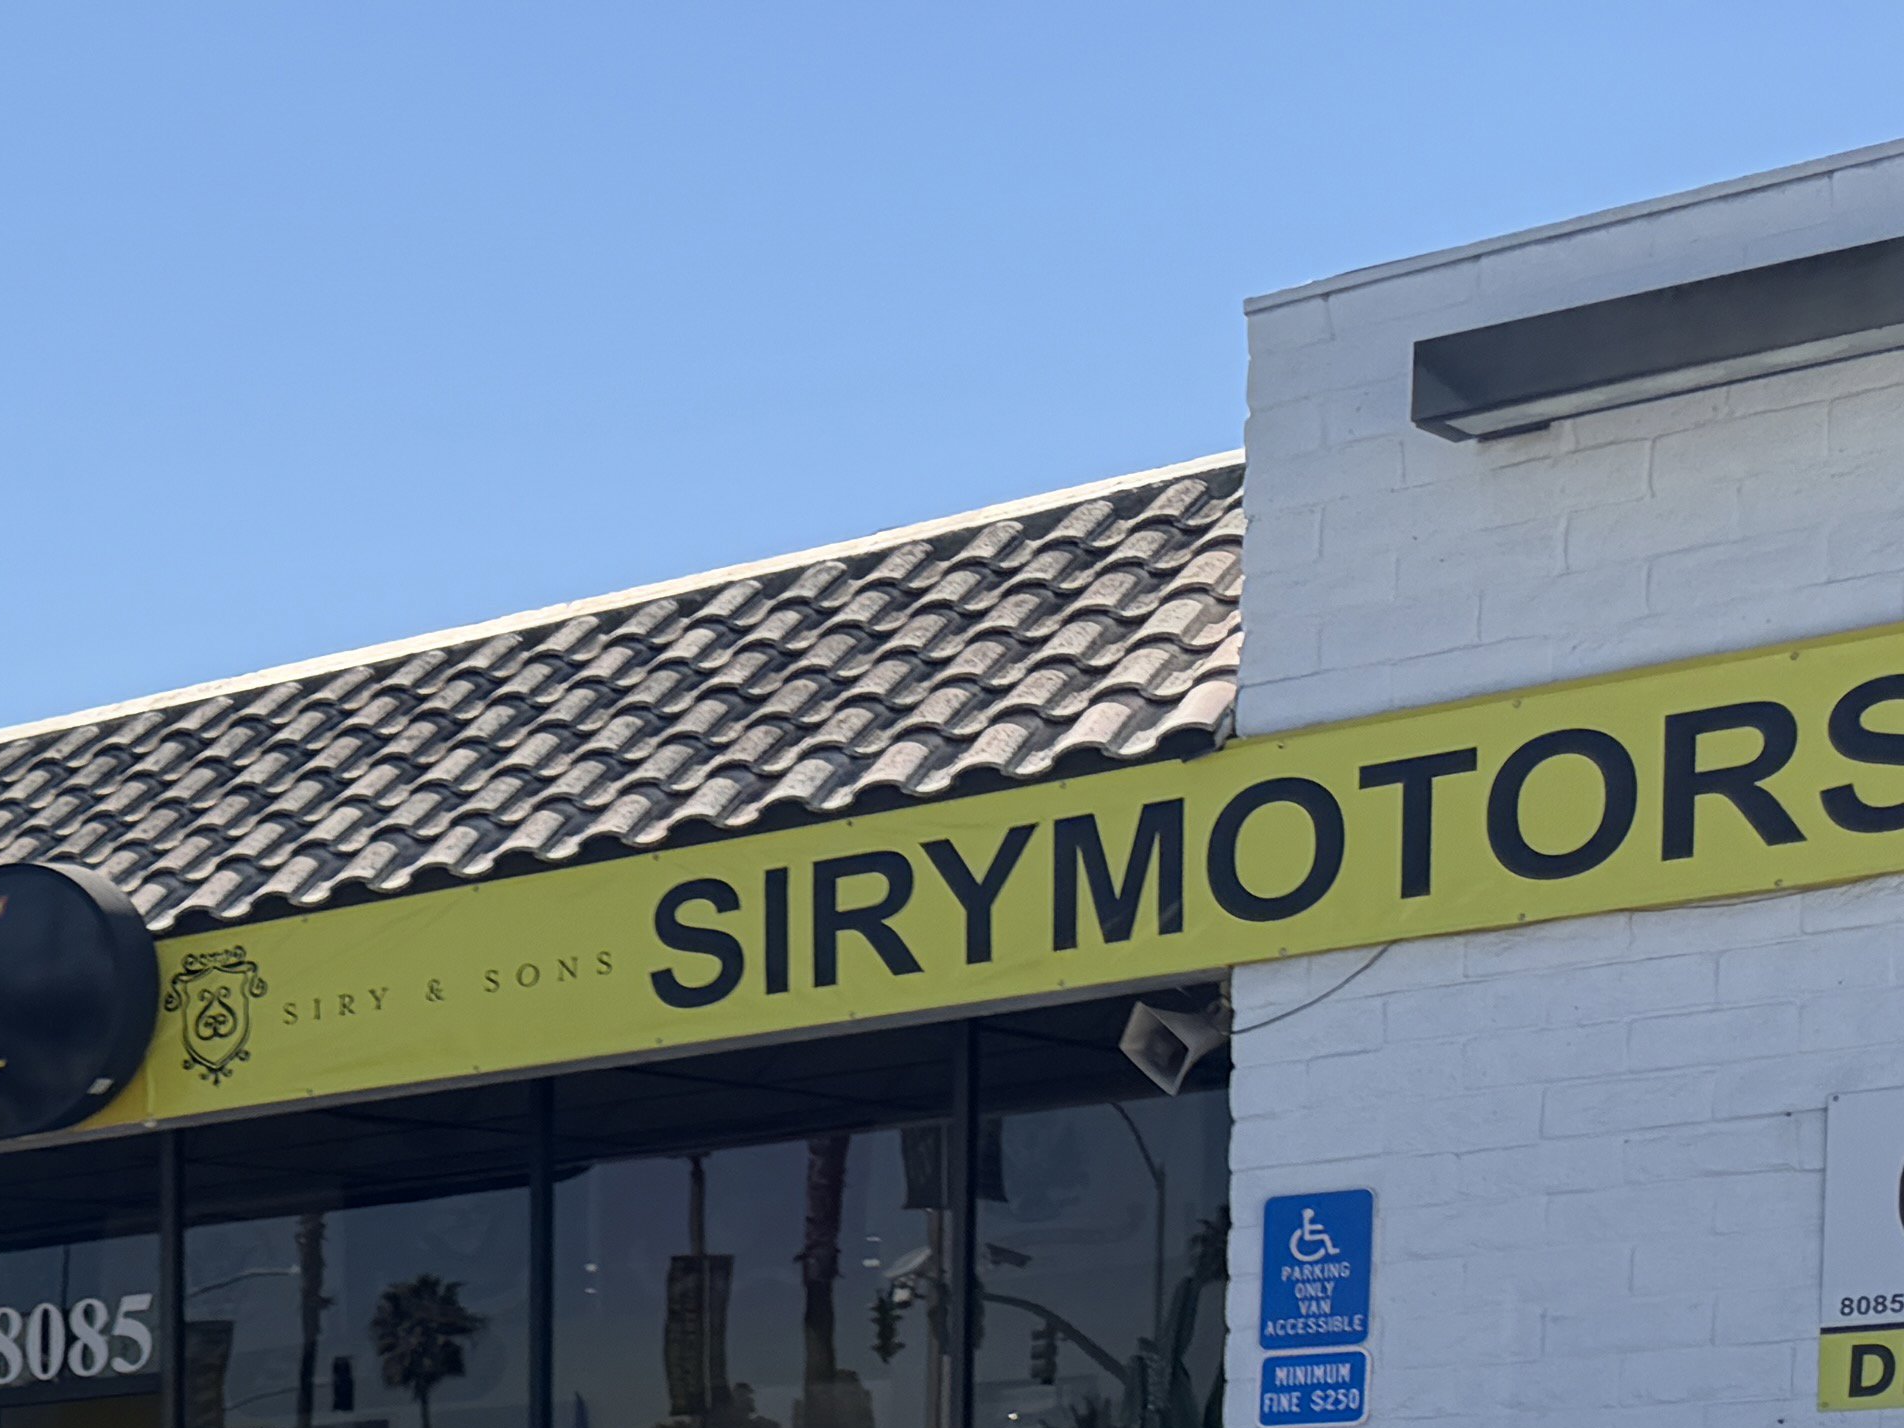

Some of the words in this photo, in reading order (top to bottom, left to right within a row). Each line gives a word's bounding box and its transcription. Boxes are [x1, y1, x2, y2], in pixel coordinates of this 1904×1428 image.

[282, 986, 389, 1026] SIRY
[425, 978, 445, 1002] &
[483, 950, 614, 994] SONS
[1281, 1261, 1351, 1282] PARKING
[1294, 1281, 1334, 1299] ONLY
[1298, 1299, 1332, 1316] VAN
[1839, 1293, 1904, 1317] 8085
[1264, 1314, 1365, 1337] ACCESSIBLE
[1274, 1362, 1352, 1387] MINIMUM
[1262, 1391, 1302, 1414] FINE
[1310, 1388, 1361, 1412] $250
